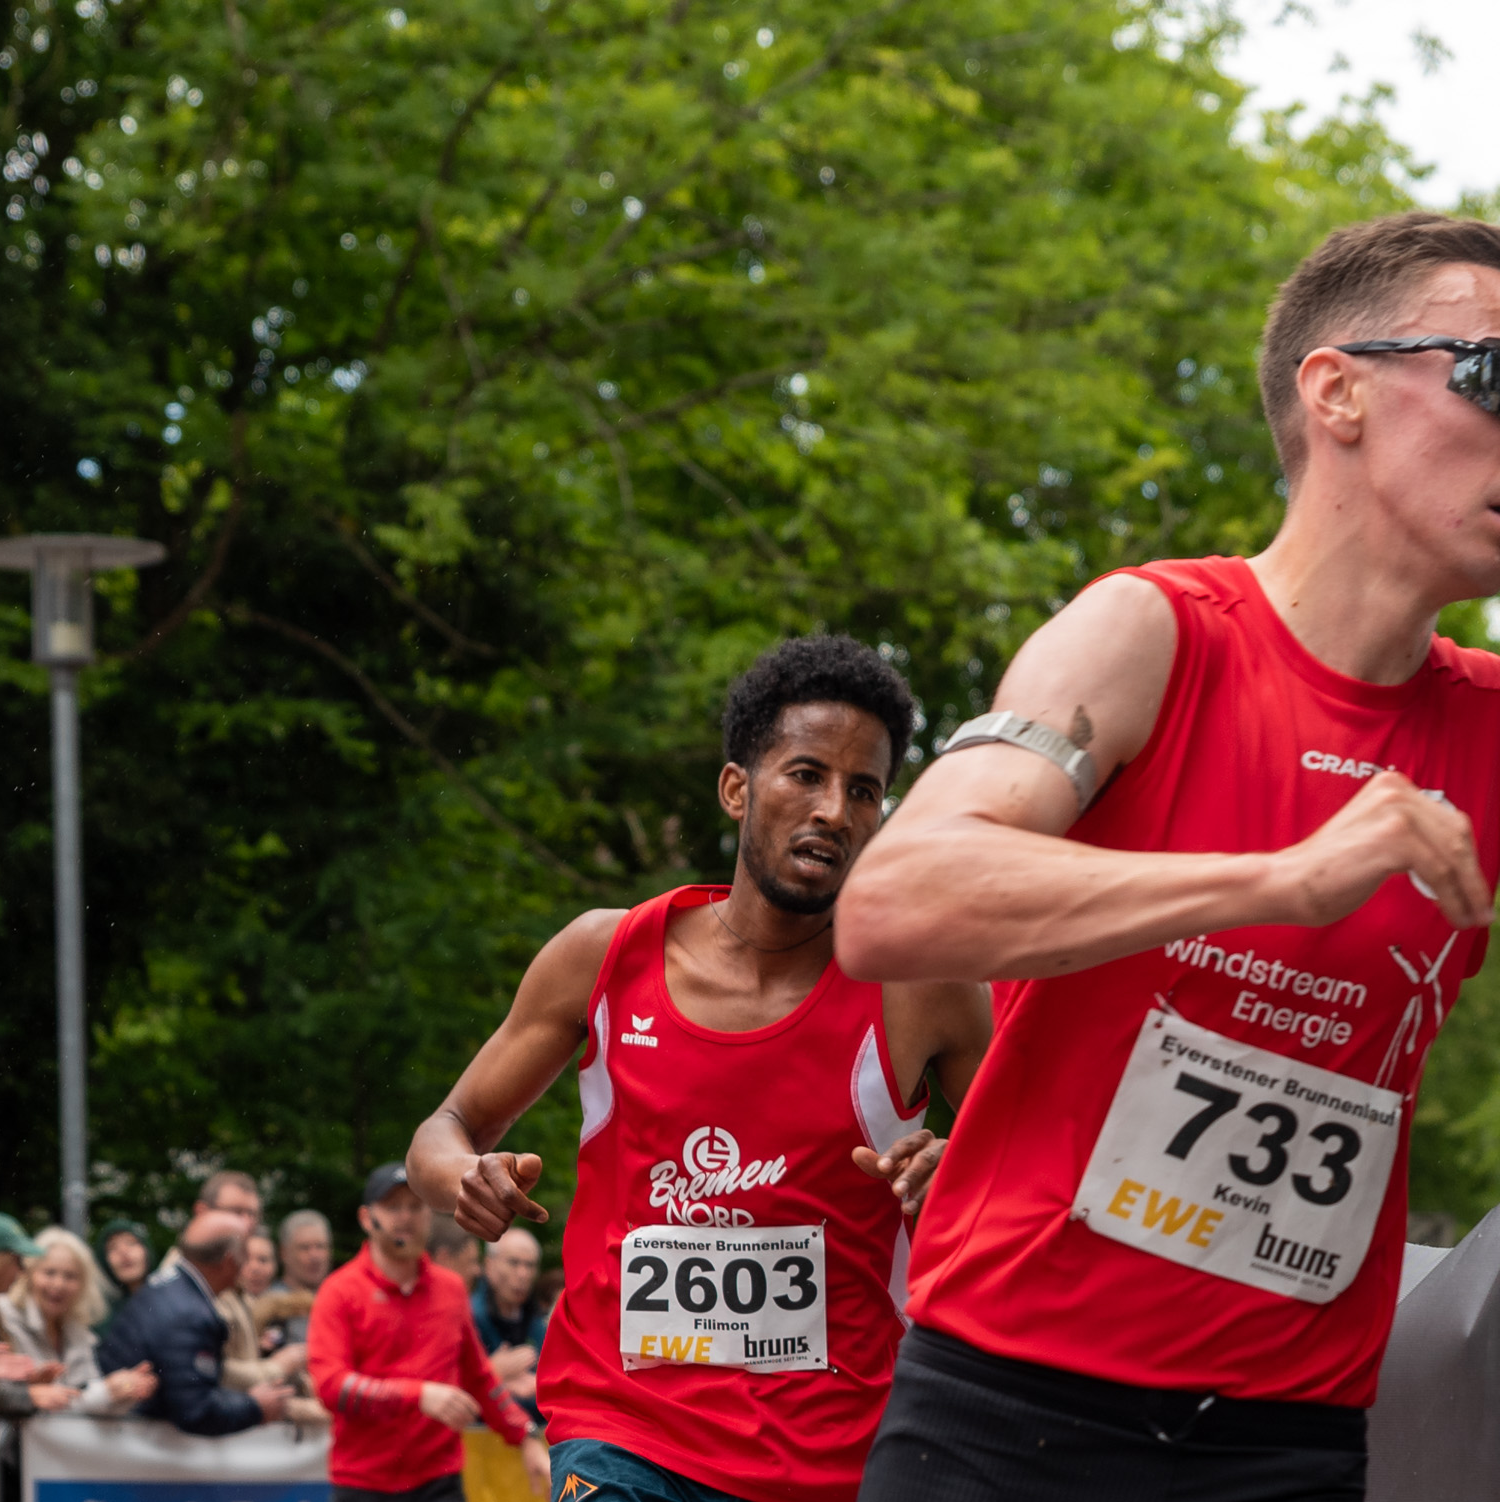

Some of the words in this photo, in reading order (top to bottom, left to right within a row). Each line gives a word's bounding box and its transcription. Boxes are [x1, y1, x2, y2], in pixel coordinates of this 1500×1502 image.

[1164, 935, 1367, 1008] windstream
[621, 1032, 658, 1048] erima
[1231, 990, 1353, 1048] Energie
[1160, 1035, 1280, 1089] Everstener
[1284, 1079, 1397, 1127] Brunnenlauf
[1164, 1071, 1362, 1206] 733
[649, 1154, 787, 1208] Bremen
[1212, 1184, 1271, 1215] Kevin
[666, 1197, 755, 1228] NORD
[1106, 1177, 1224, 1249] EWE
[633, 1237, 711, 1251] Everstener
[716, 1238, 810, 1251] Brunnenlauf
[1254, 1222, 1342, 1280] bruns
[625, 1255, 818, 1314] 2603
[640, 1335, 713, 1363] EWE
[693, 1318, 750, 1331] Filimon
[744, 1334, 808, 1358] bruns
